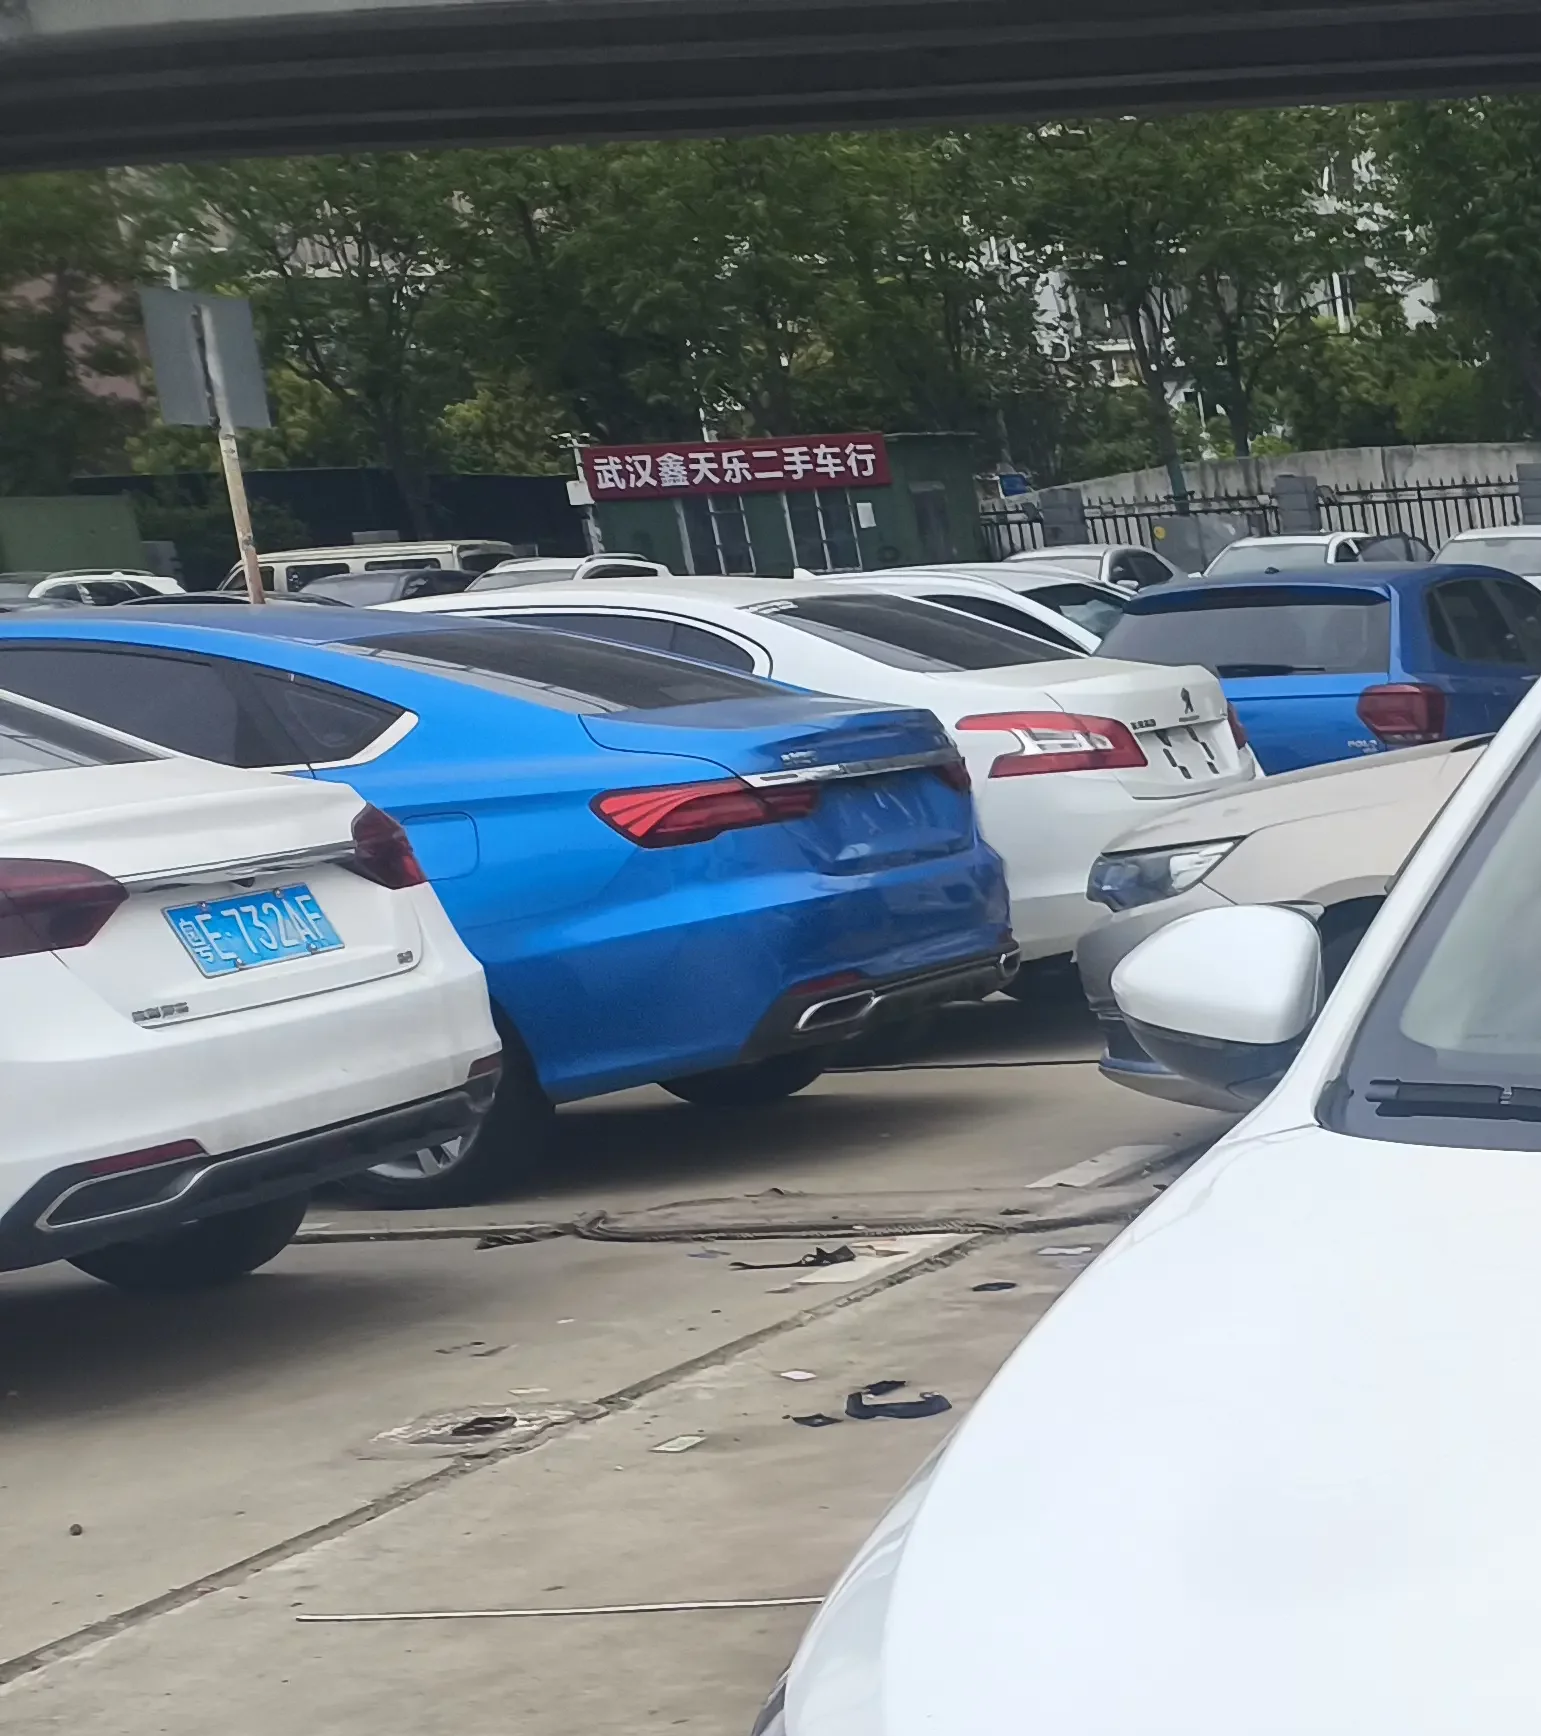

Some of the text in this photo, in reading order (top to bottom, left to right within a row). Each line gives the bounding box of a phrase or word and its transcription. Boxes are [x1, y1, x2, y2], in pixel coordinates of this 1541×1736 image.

[593, 442, 876, 490] 武汉鑫天乐二手车行
